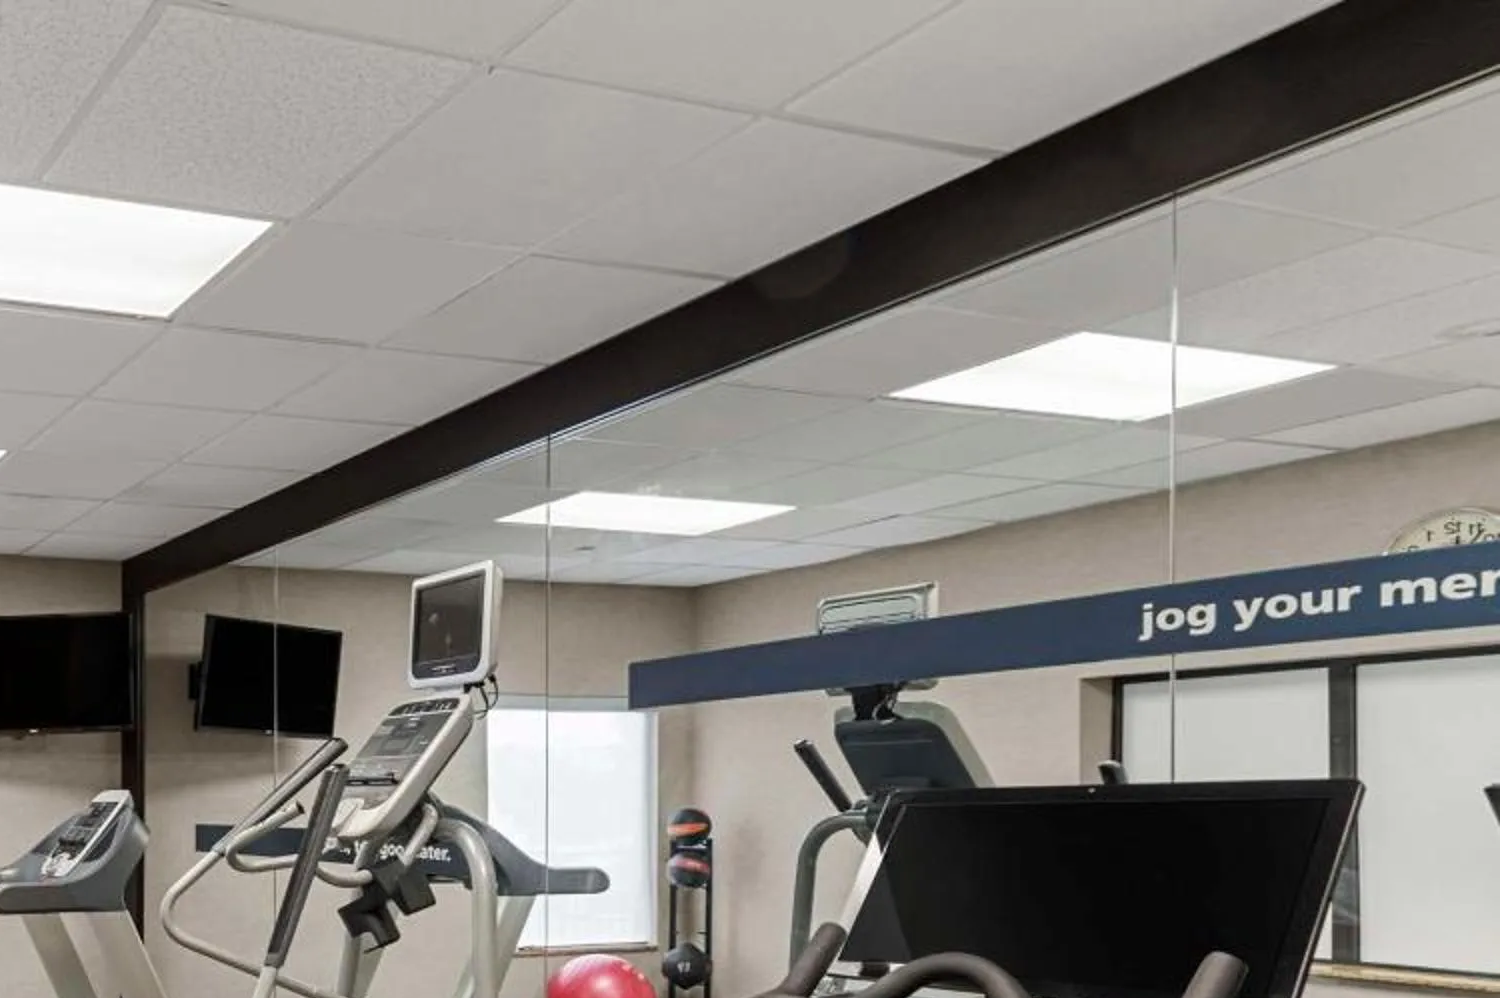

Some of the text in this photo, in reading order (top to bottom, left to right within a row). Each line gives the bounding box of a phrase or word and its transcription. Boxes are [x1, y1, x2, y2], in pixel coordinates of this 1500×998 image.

[1138, 602, 1216, 642] jog
[1233, 583, 1362, 633] your
[415, 844, 452, 862] ater.
